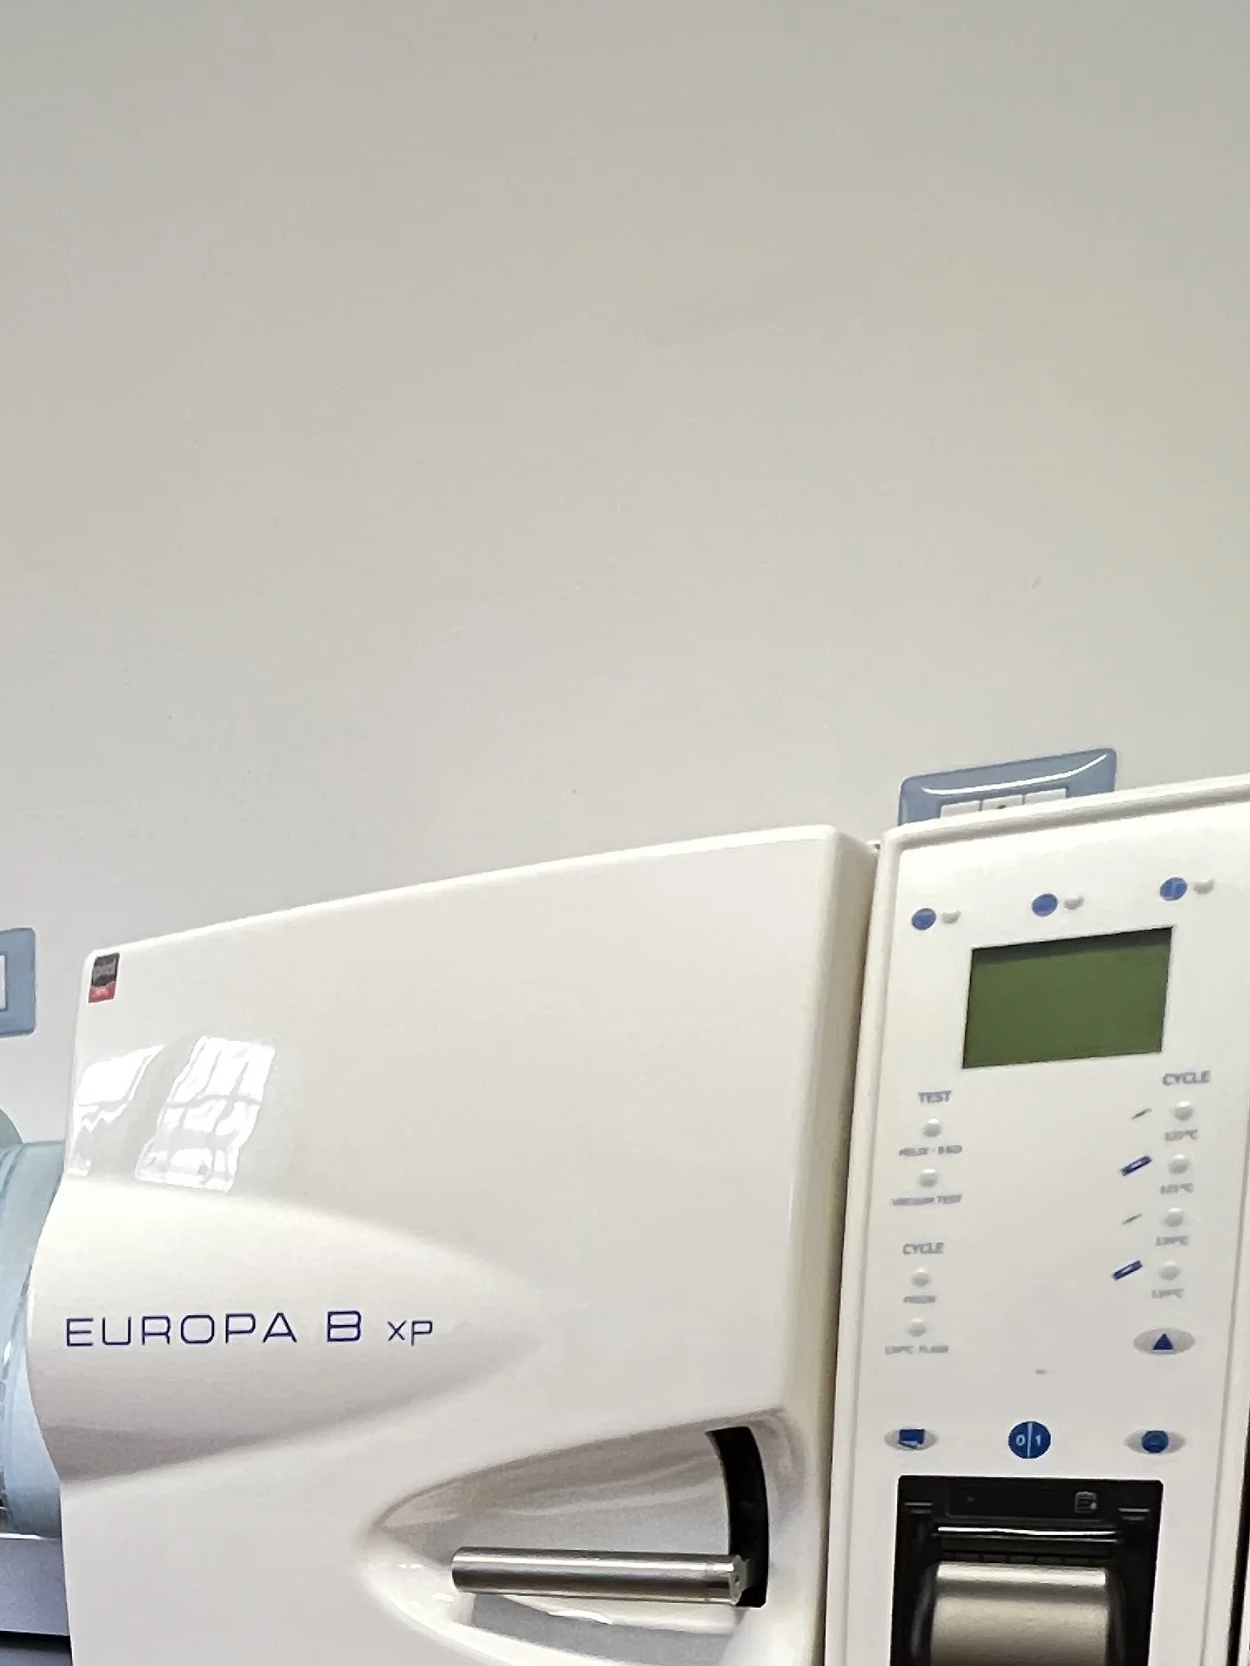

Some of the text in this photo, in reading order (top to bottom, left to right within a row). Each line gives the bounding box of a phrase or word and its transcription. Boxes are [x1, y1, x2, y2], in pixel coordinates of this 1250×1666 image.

[1162, 1070, 1211, 1086] CYCLE
[918, 1090, 952, 1104] TEST
[902, 1242, 945, 1255] CYCLE
[66, 1312, 297, 1347] EUROPA
[327, 1310, 362, 1342] B
